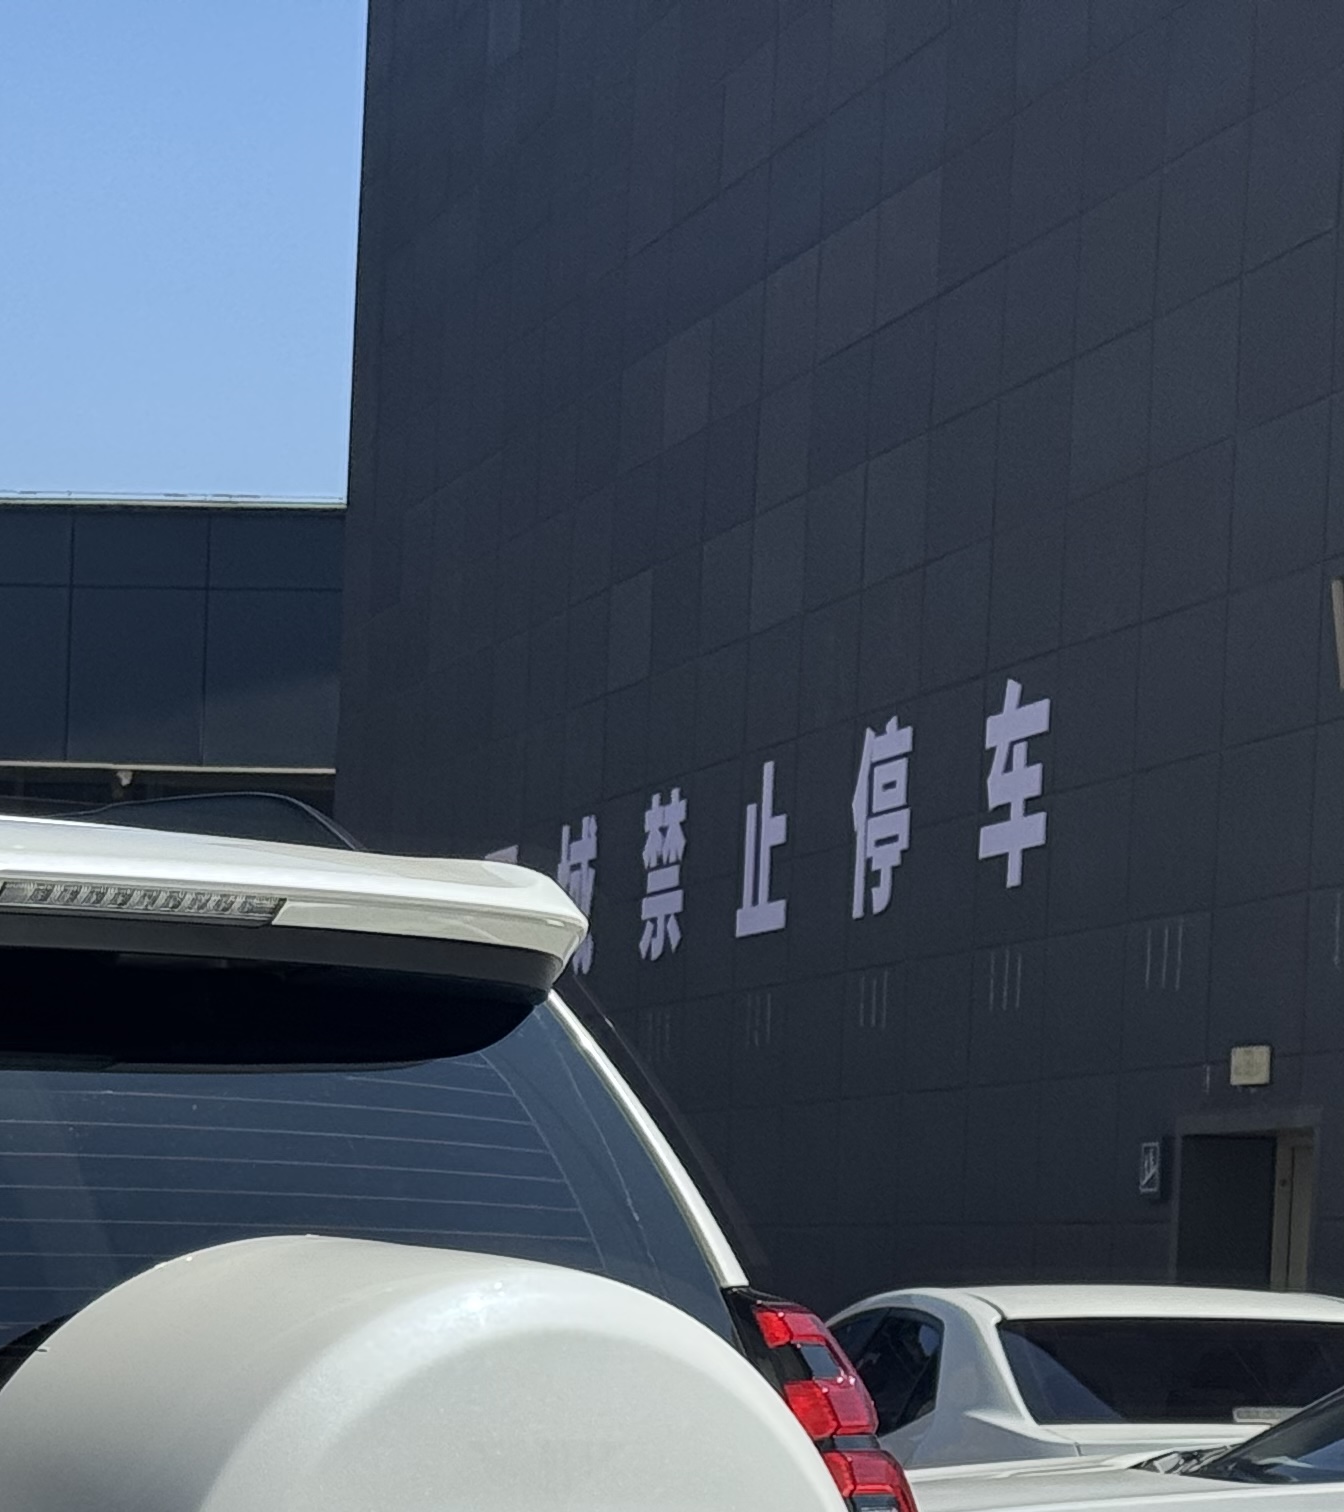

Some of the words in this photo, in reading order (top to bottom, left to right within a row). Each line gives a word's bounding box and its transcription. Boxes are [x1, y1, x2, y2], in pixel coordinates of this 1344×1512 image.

[485, 679, 1051, 976] 域禁止停车
